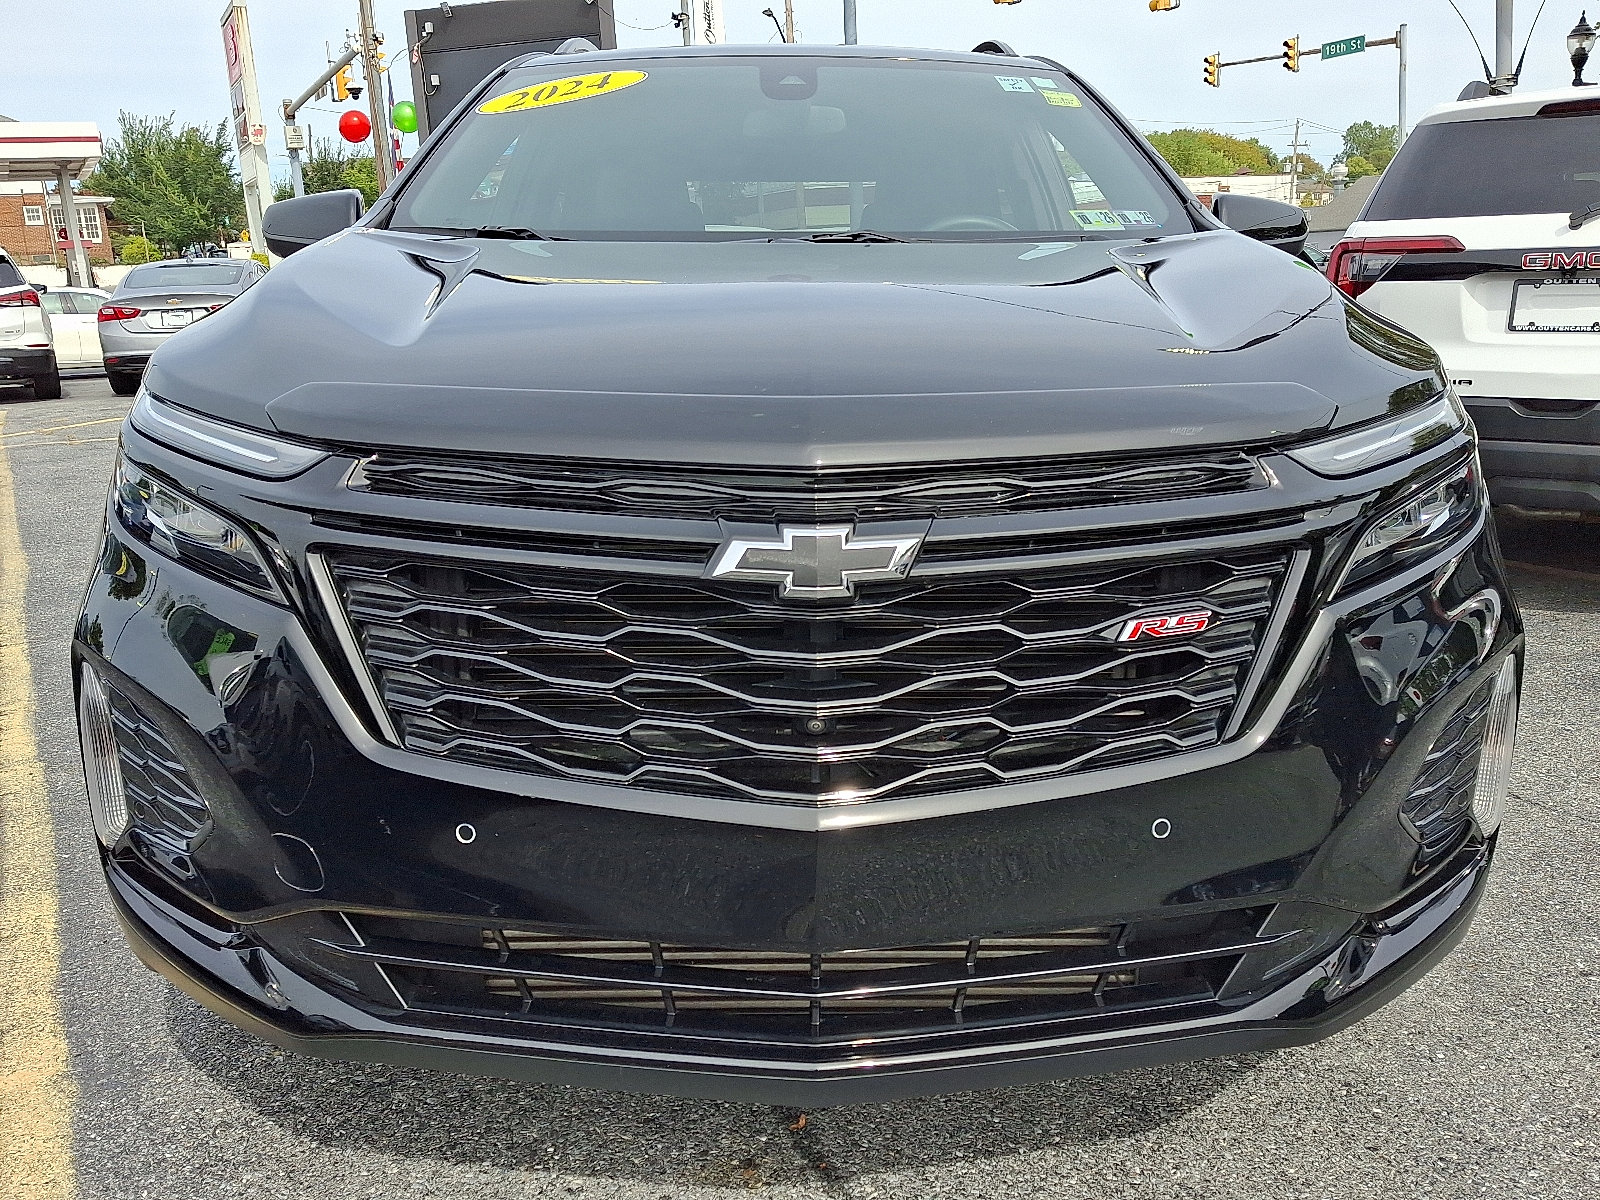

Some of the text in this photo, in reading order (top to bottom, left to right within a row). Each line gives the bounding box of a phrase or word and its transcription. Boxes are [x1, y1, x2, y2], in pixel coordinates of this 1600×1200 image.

[1325, 39, 1361, 56] 19th St
[504, 73, 612, 110] 2024
[1077, 211, 1116, 225] 10 26
[1117, 211, 1155, 224] 10 26
[1118, 611, 1212, 642] RS
